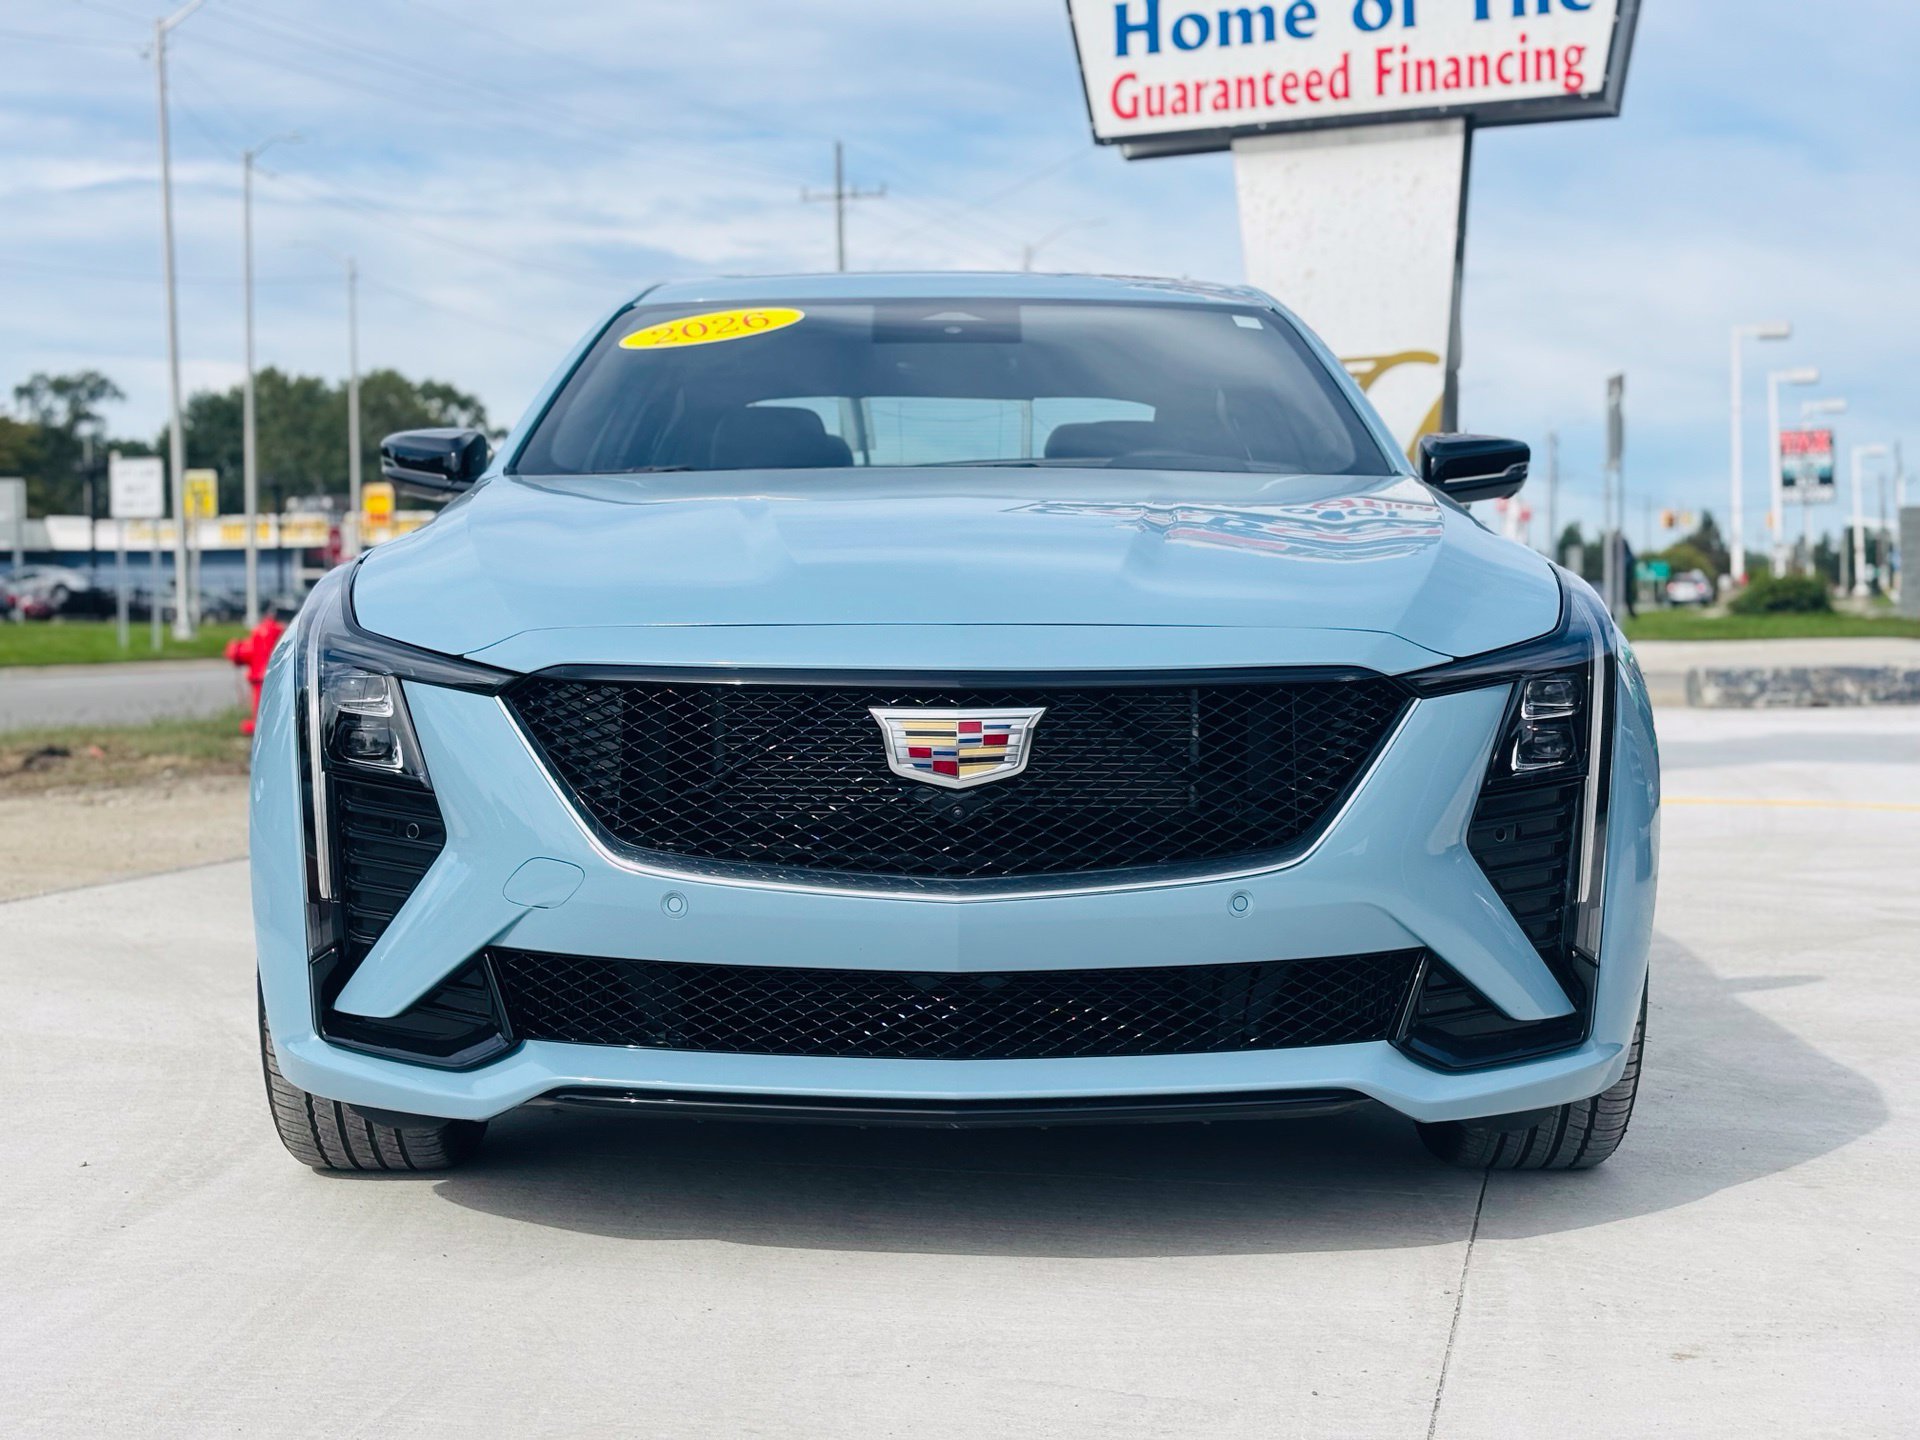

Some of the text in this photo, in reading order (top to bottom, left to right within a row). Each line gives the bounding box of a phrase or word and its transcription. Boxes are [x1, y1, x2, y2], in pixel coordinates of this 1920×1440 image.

[1115, 0, 1316, 57] Home
[1110, 33, 1586, 120] Guaranteed Financing
[651, 312, 770, 345] 2026
